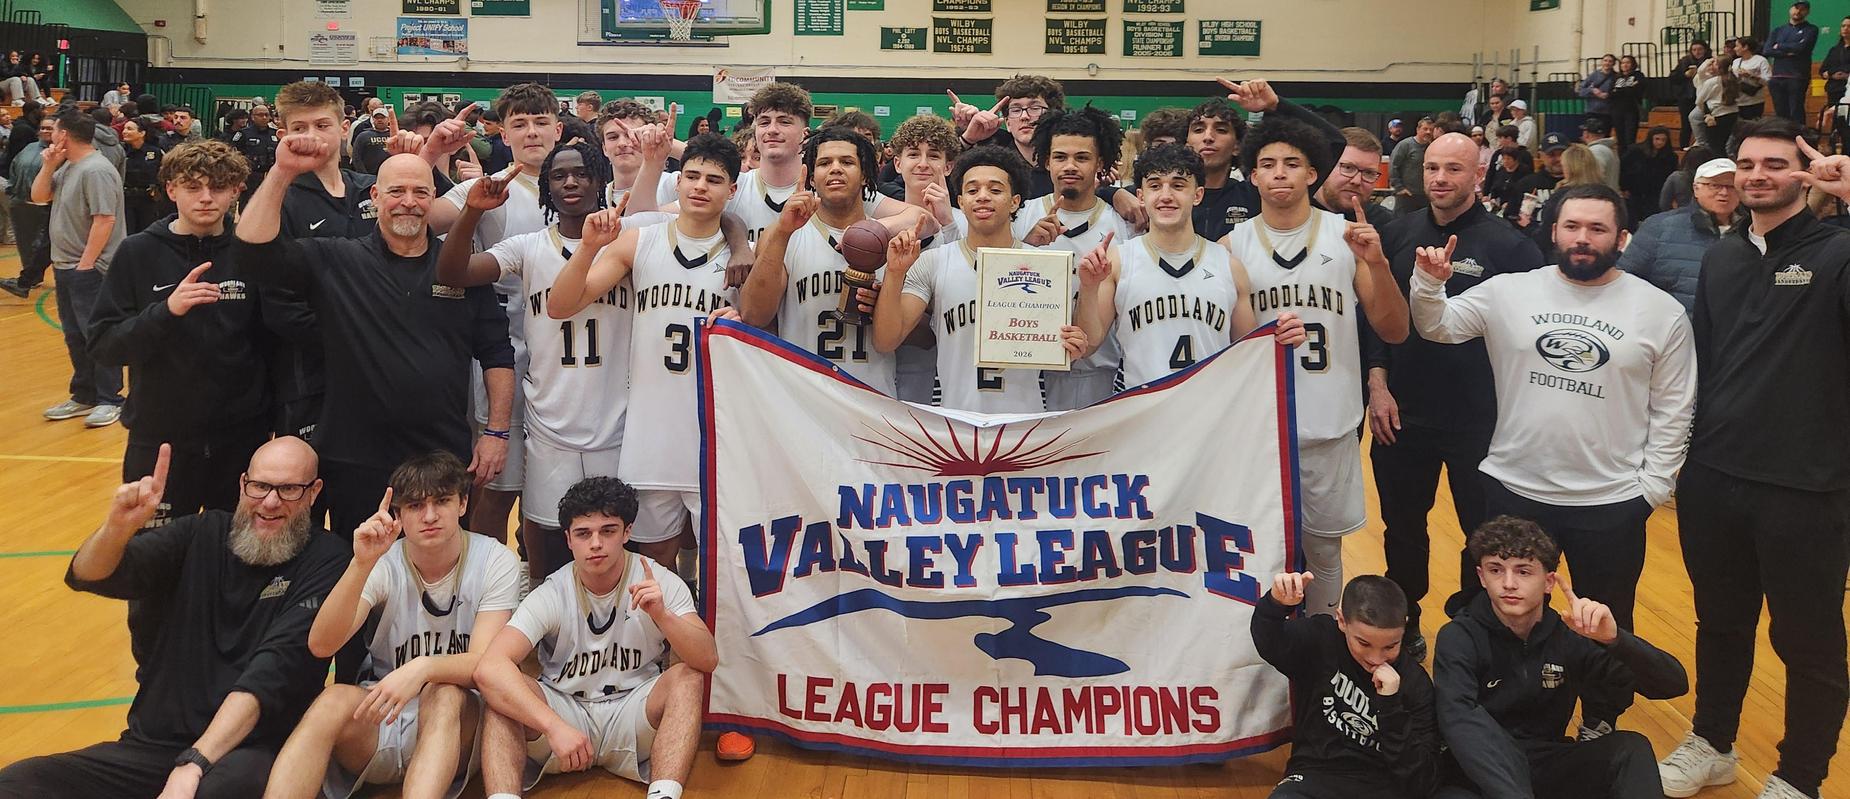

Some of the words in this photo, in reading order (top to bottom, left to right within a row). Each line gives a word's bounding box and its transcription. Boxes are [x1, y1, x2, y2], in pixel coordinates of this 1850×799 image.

[1137, 4, 1171, 12] 1992-93
[400, 23, 422, 33] Project
[443, 24, 464, 32] School
[950, 20, 976, 28] WILBY
[952, 28, 990, 36] BASKETBALL
[1047, 28, 1062, 36] BOYS
[1065, 28, 1104, 36] BASKETBALL
[1063, 20, 1088, 28] WILBY
[936, 36, 953, 44] NVL
[956, 36, 989, 44] CHAMPS
[1049, 36, 1065, 44] NVL
[1069, 37, 1102, 45] CHAMPS
[997, 276, 1024, 286] VALLEY
[1024, 276, 1052, 288] LEAGUE
[637, 283, 731, 316] WOODLAN
[1128, 294, 1226, 333] WOODLAND
[817, 310, 869, 363] 21
[1530, 312, 1625, 341] WOODLAND
[559, 318, 602, 368] 11
[664, 323, 693, 375] 3
[1168, 334, 1196, 371] 4
[1529, 370, 1605, 399] FOOTBALL
[838, 474, 1154, 529] NAUGATUCK
[738, 514, 984, 598] VALLEY
[996, 511, 1262, 606] LEAGUE
[776, 672, 950, 735] LEAGUE
[972, 684, 1221, 736] CHAMPIONS
